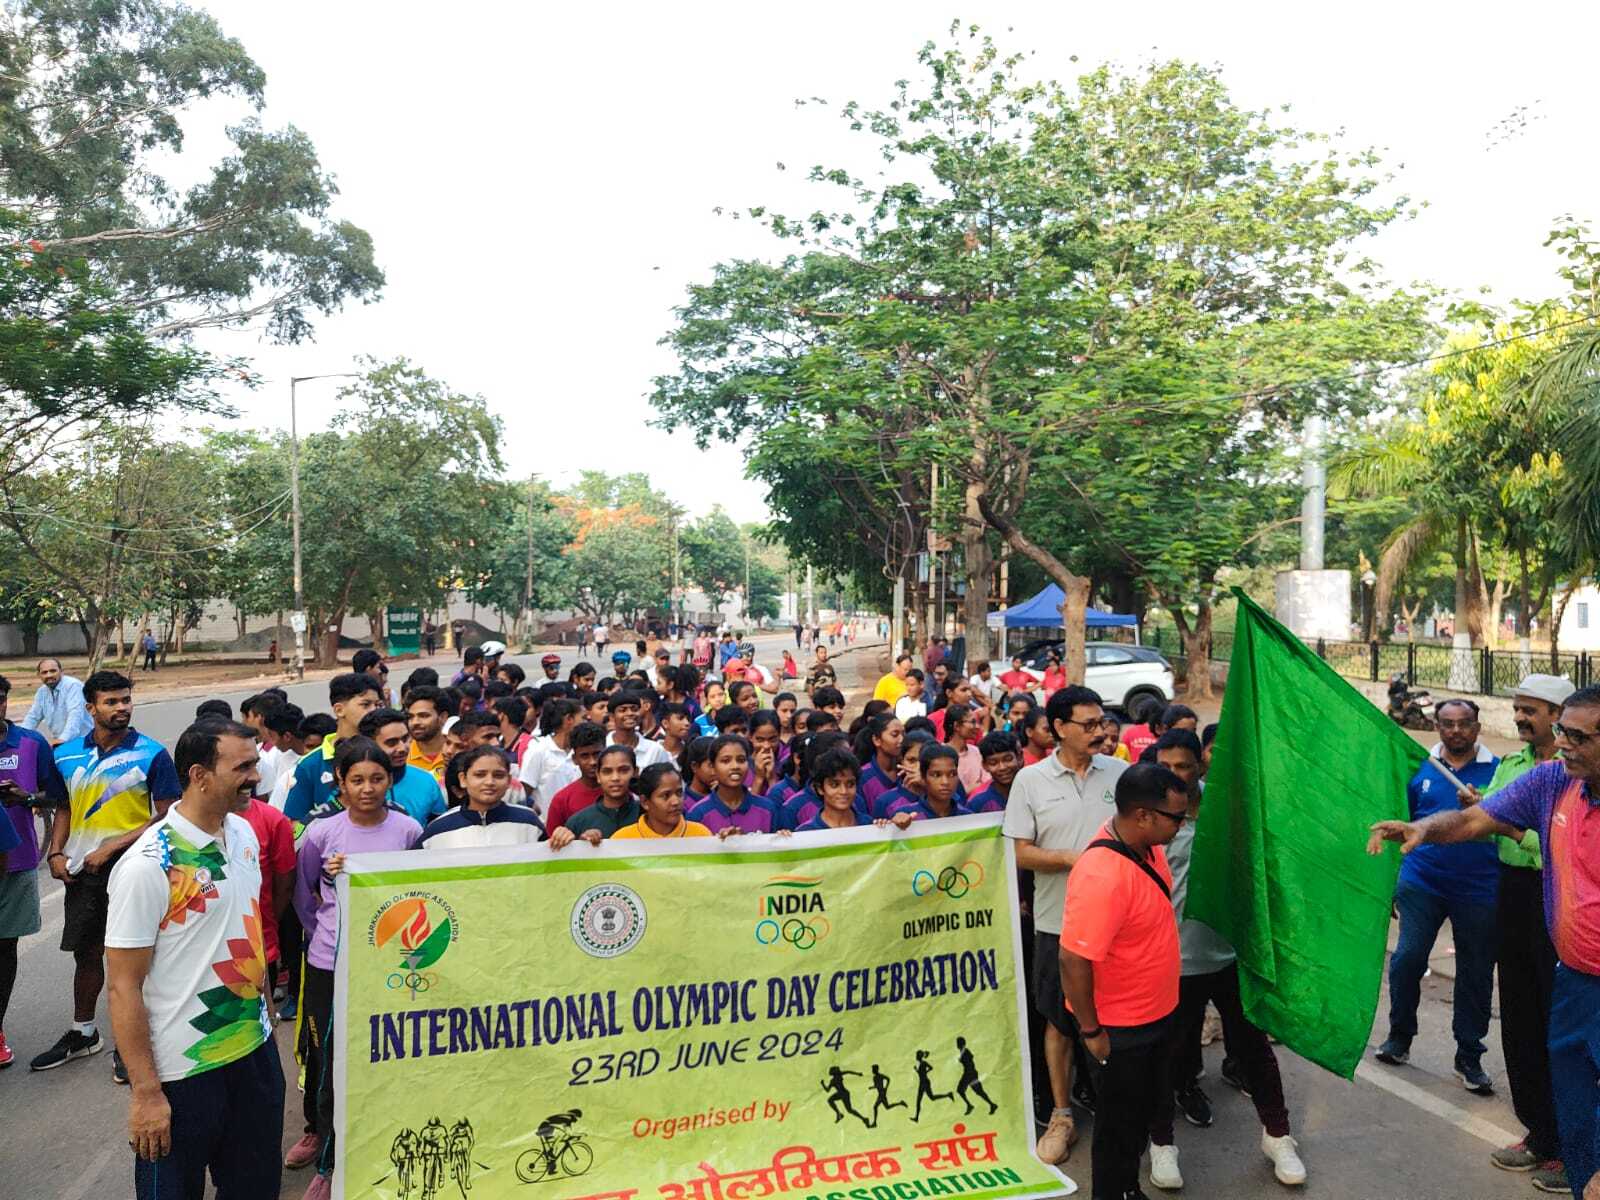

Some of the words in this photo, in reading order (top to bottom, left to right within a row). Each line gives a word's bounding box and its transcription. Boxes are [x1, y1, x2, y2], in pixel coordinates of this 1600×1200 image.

[368, 901, 392, 946] JHARKHAND
[392, 890, 431, 902] OLYMPIC
[432, 895, 460, 943] ASSOCIATION
[759, 892, 826, 917] INDIA
[903, 912, 961, 939] OLYMPIC
[965, 909, 994, 929] DAY
[370, 990, 623, 1063] INTERNATIONAL
[632, 979, 757, 1033] OLYMPIC
[767, 974, 820, 1019] DAY
[828, 949, 999, 1013] CELEBRATION
[568, 1047, 660, 1087] 23RD
[668, 1036, 750, 1073] JUNE
[757, 1026, 845, 1062] 2024
[632, 1102, 757, 1141] Organised
[762, 1099, 791, 1121] by
[914, 1122, 999, 1171] संघ
